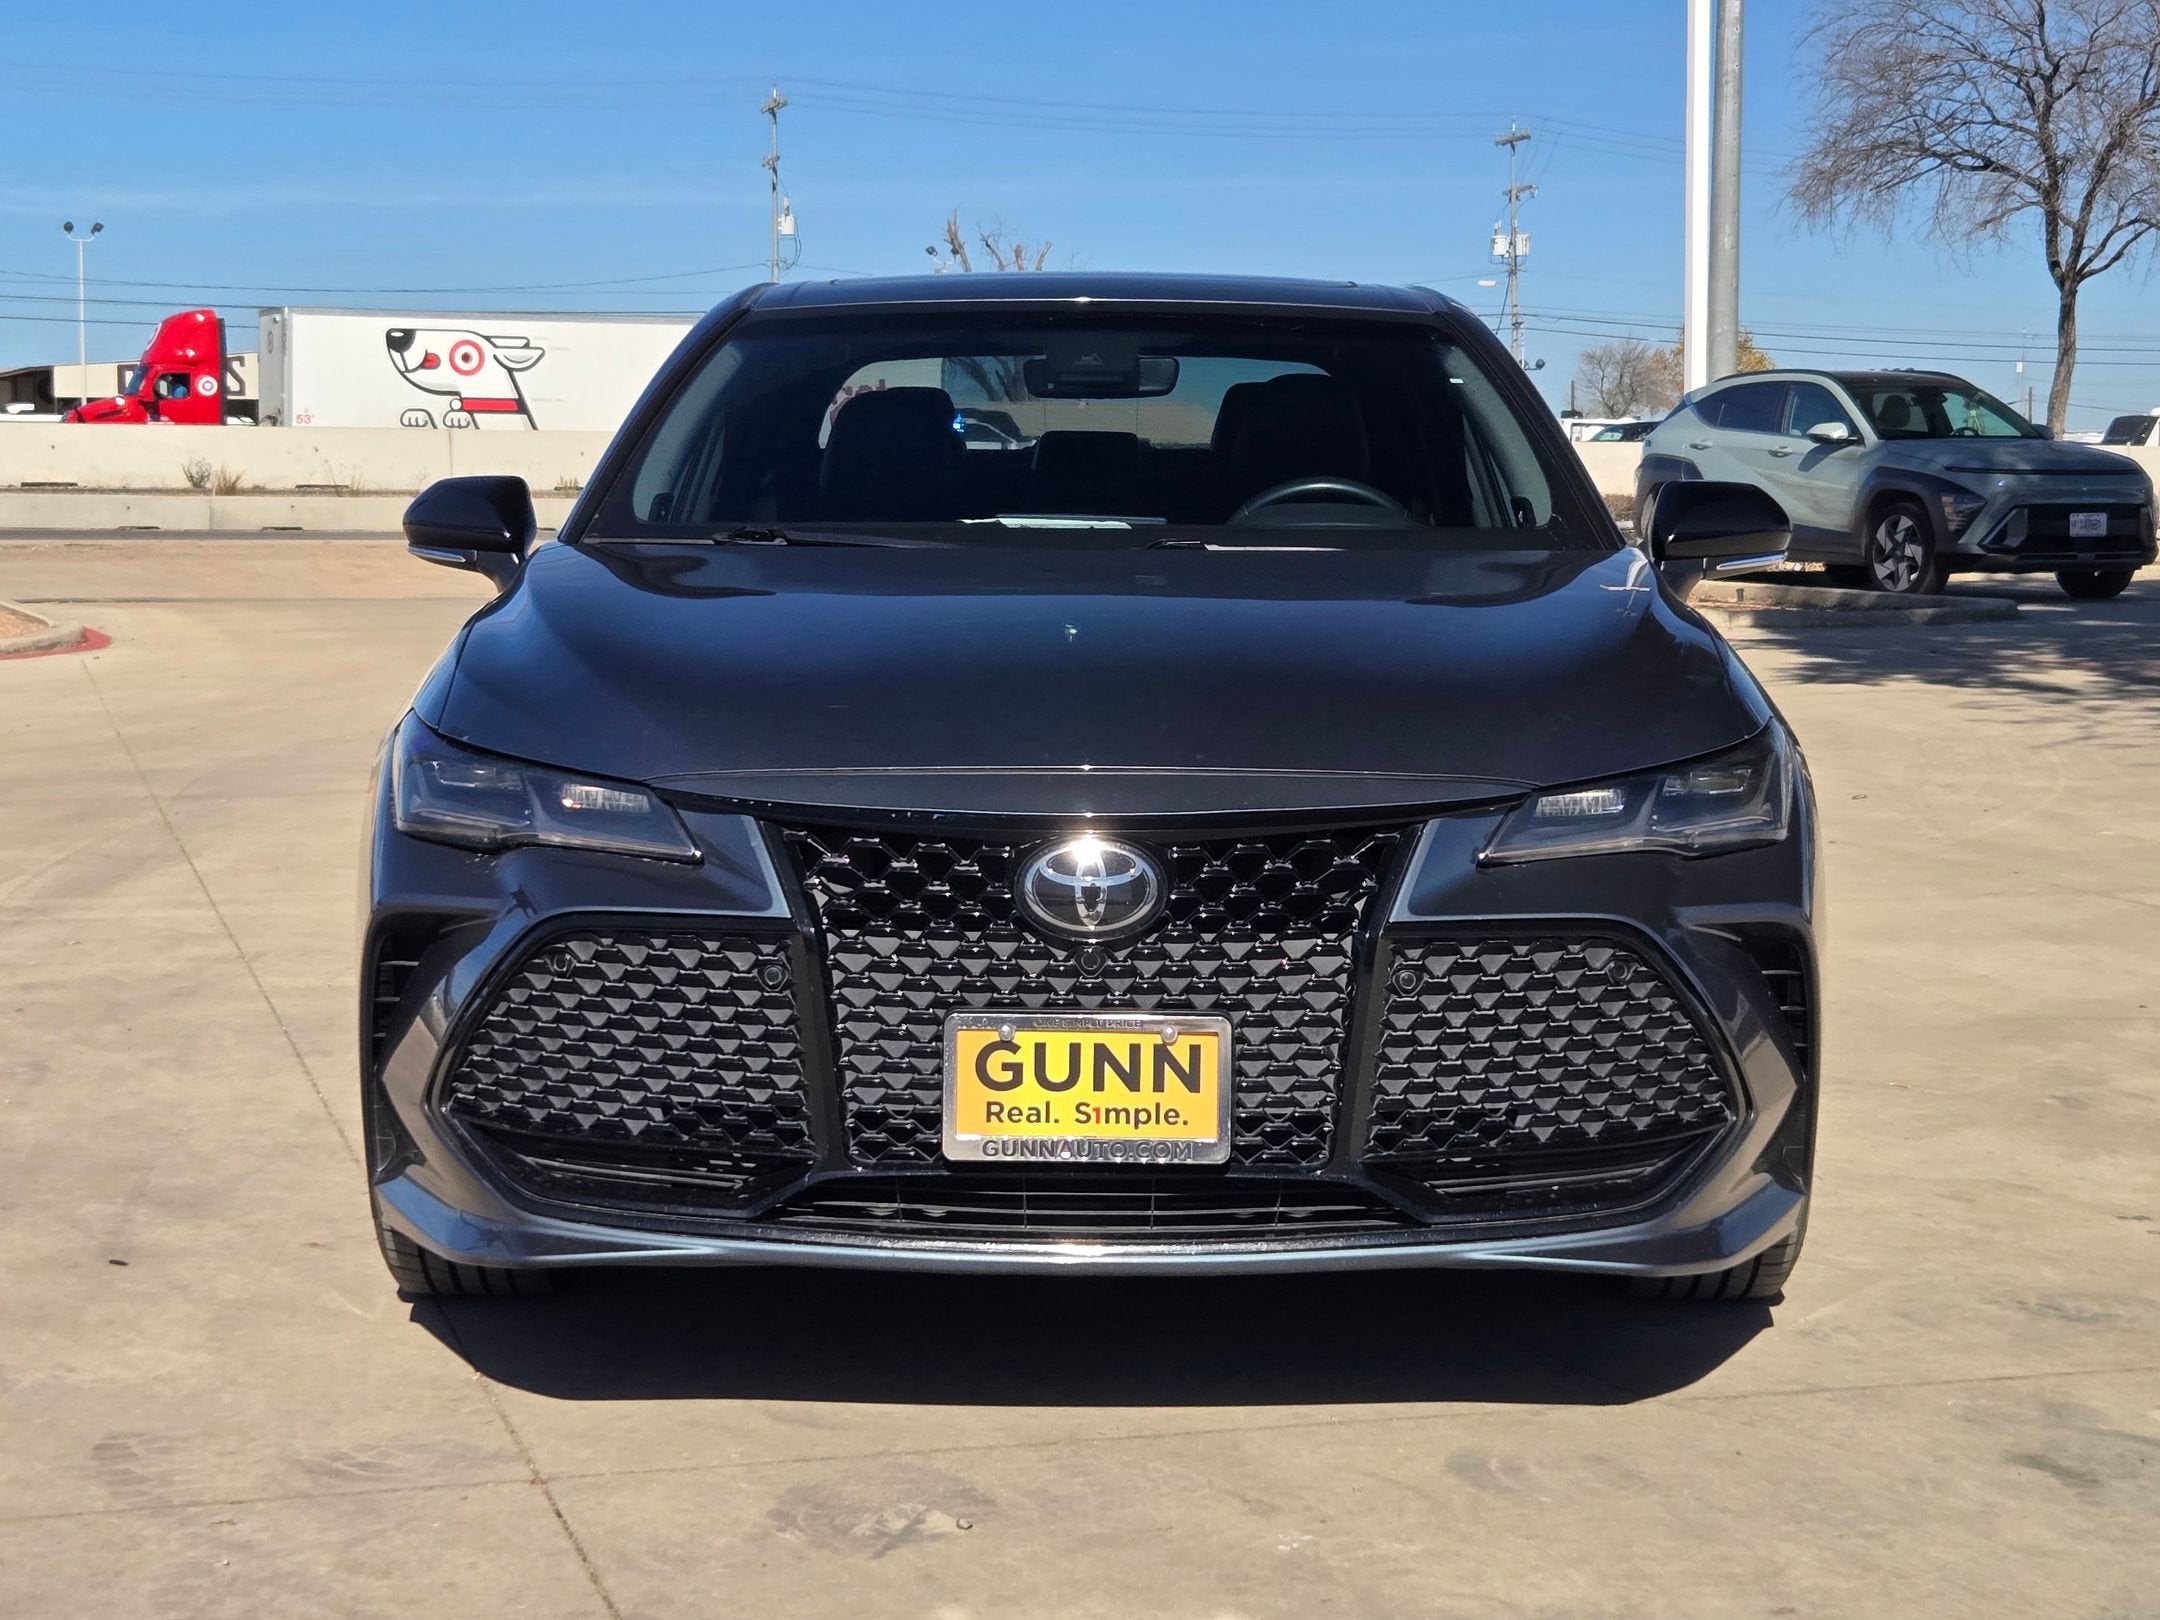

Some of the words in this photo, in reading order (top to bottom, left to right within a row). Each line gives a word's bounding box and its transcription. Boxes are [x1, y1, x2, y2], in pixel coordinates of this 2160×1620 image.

[1062, 1018, 1103, 1028] SIMPLE
[1106, 1019, 1142, 1028] PRICE
[975, 1040, 1201, 1093] GUNN
[986, 1101, 1060, 1123] Real.
[982, 1139, 1193, 1161] GUNNAUTO.COM
